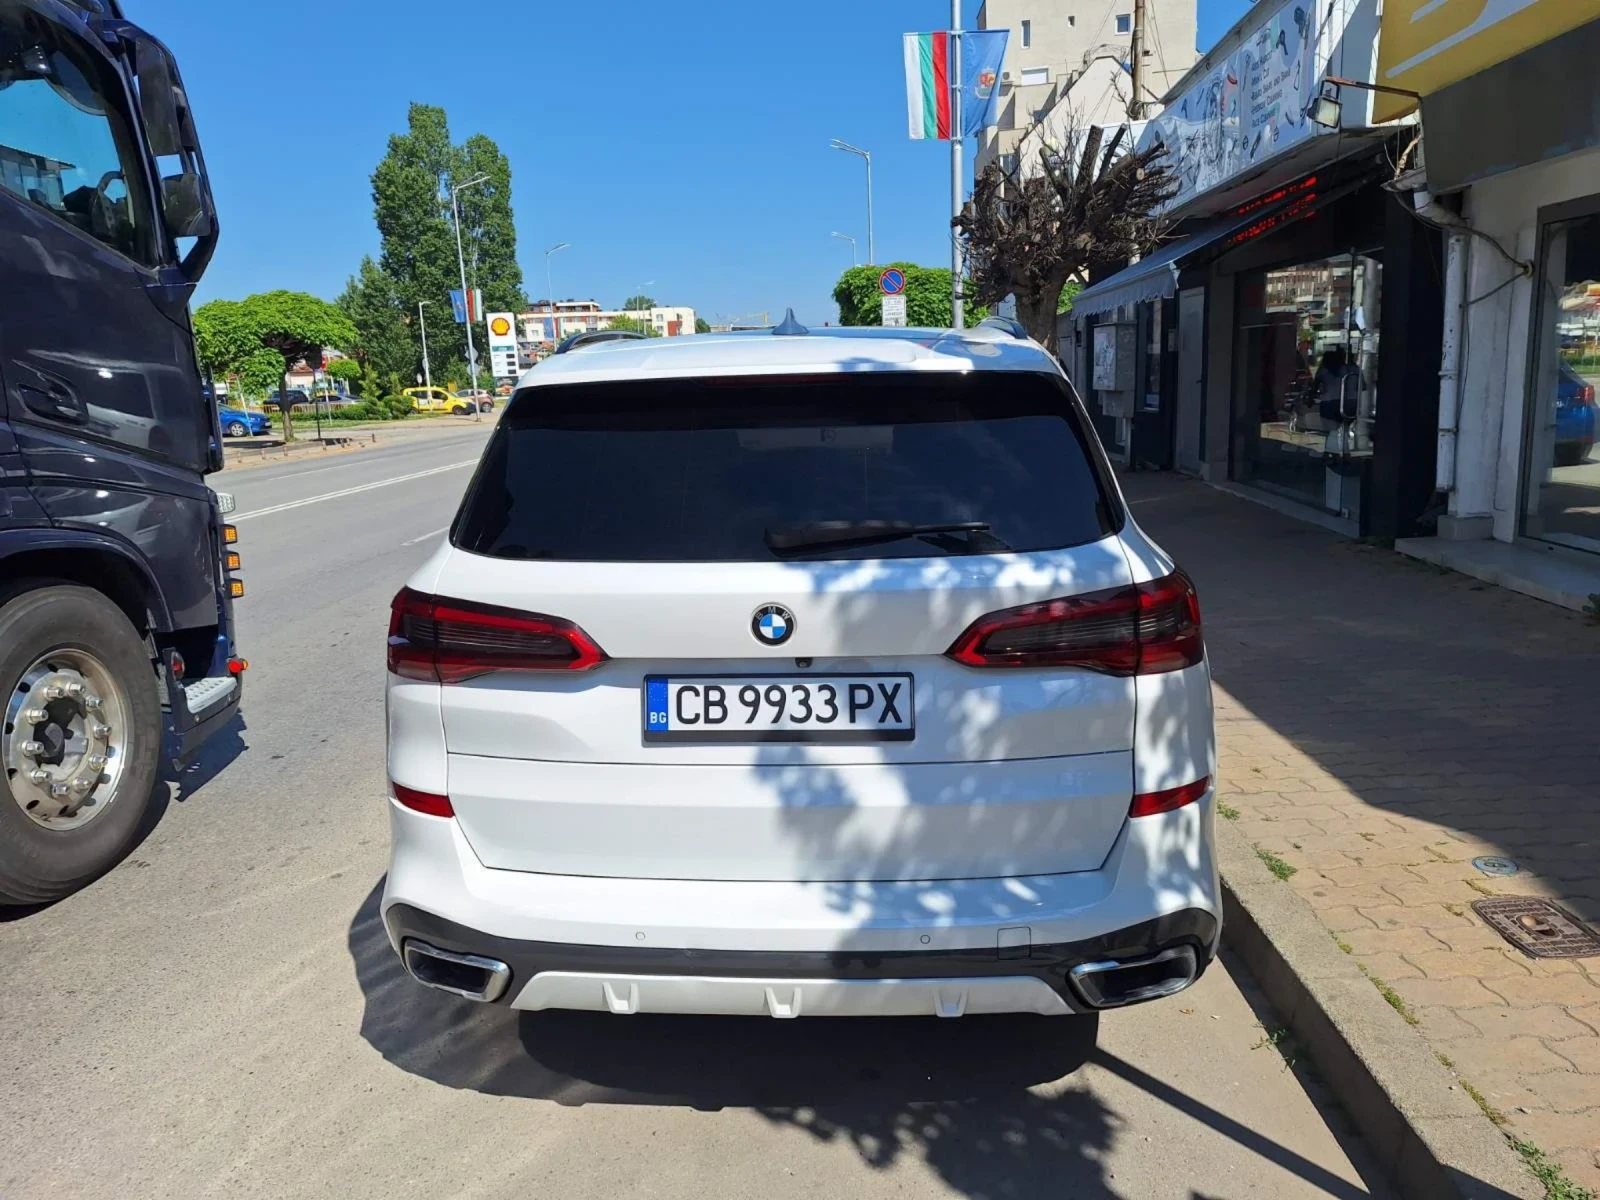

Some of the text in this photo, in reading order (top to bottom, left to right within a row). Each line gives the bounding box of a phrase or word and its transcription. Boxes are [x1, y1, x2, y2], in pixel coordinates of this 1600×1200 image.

[755, 606, 791, 620] BMW
[676, 683, 903, 725] CB 9933 PX
[650, 712, 667, 724] BG
